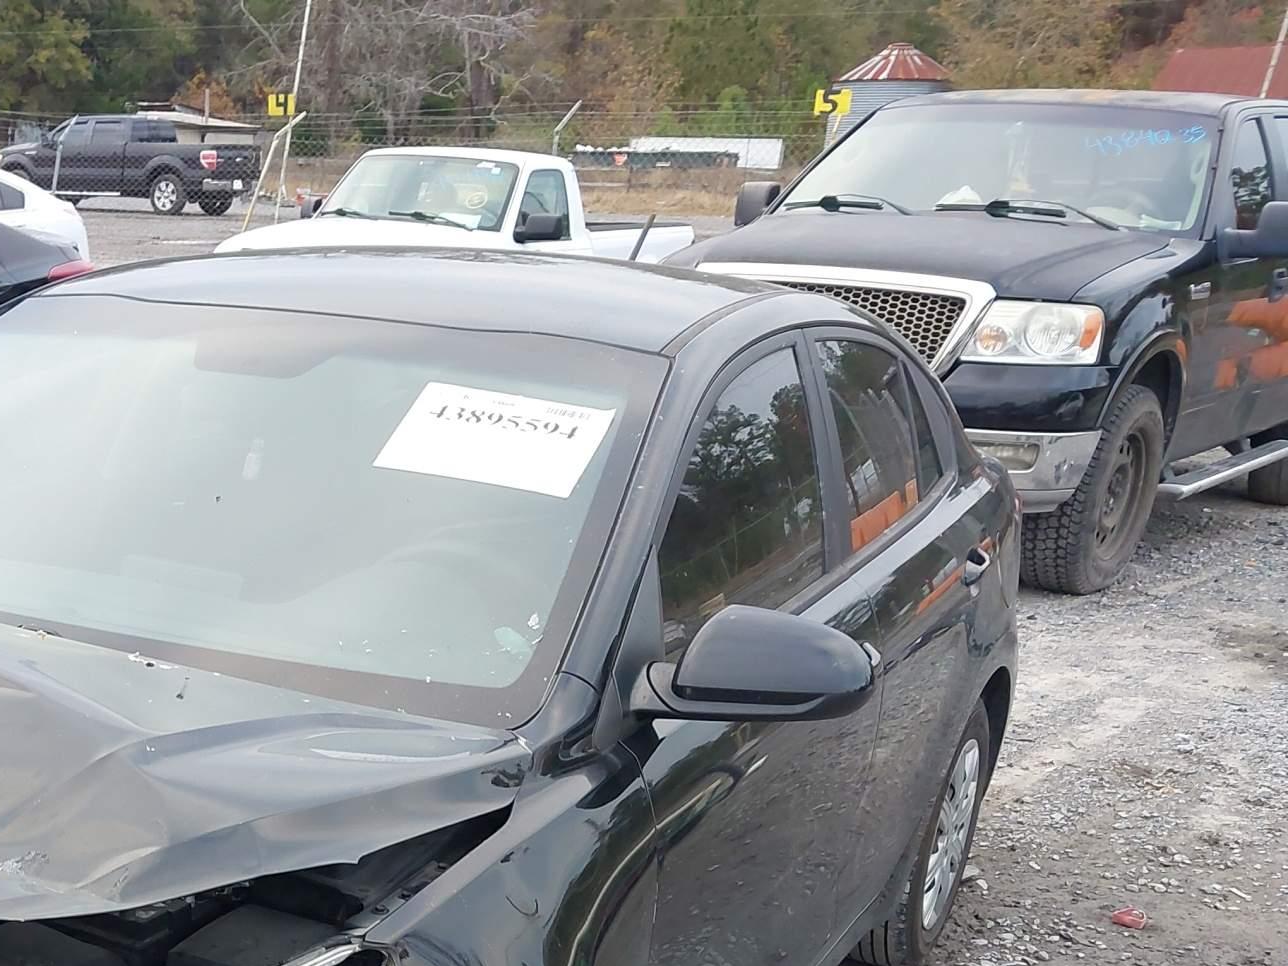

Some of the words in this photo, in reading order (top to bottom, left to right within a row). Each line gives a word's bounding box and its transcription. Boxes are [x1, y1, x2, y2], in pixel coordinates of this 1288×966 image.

[275, 93, 288, 115] 4
[818, 88, 842, 115] 5
[429, 404, 580, 440] 43895594
